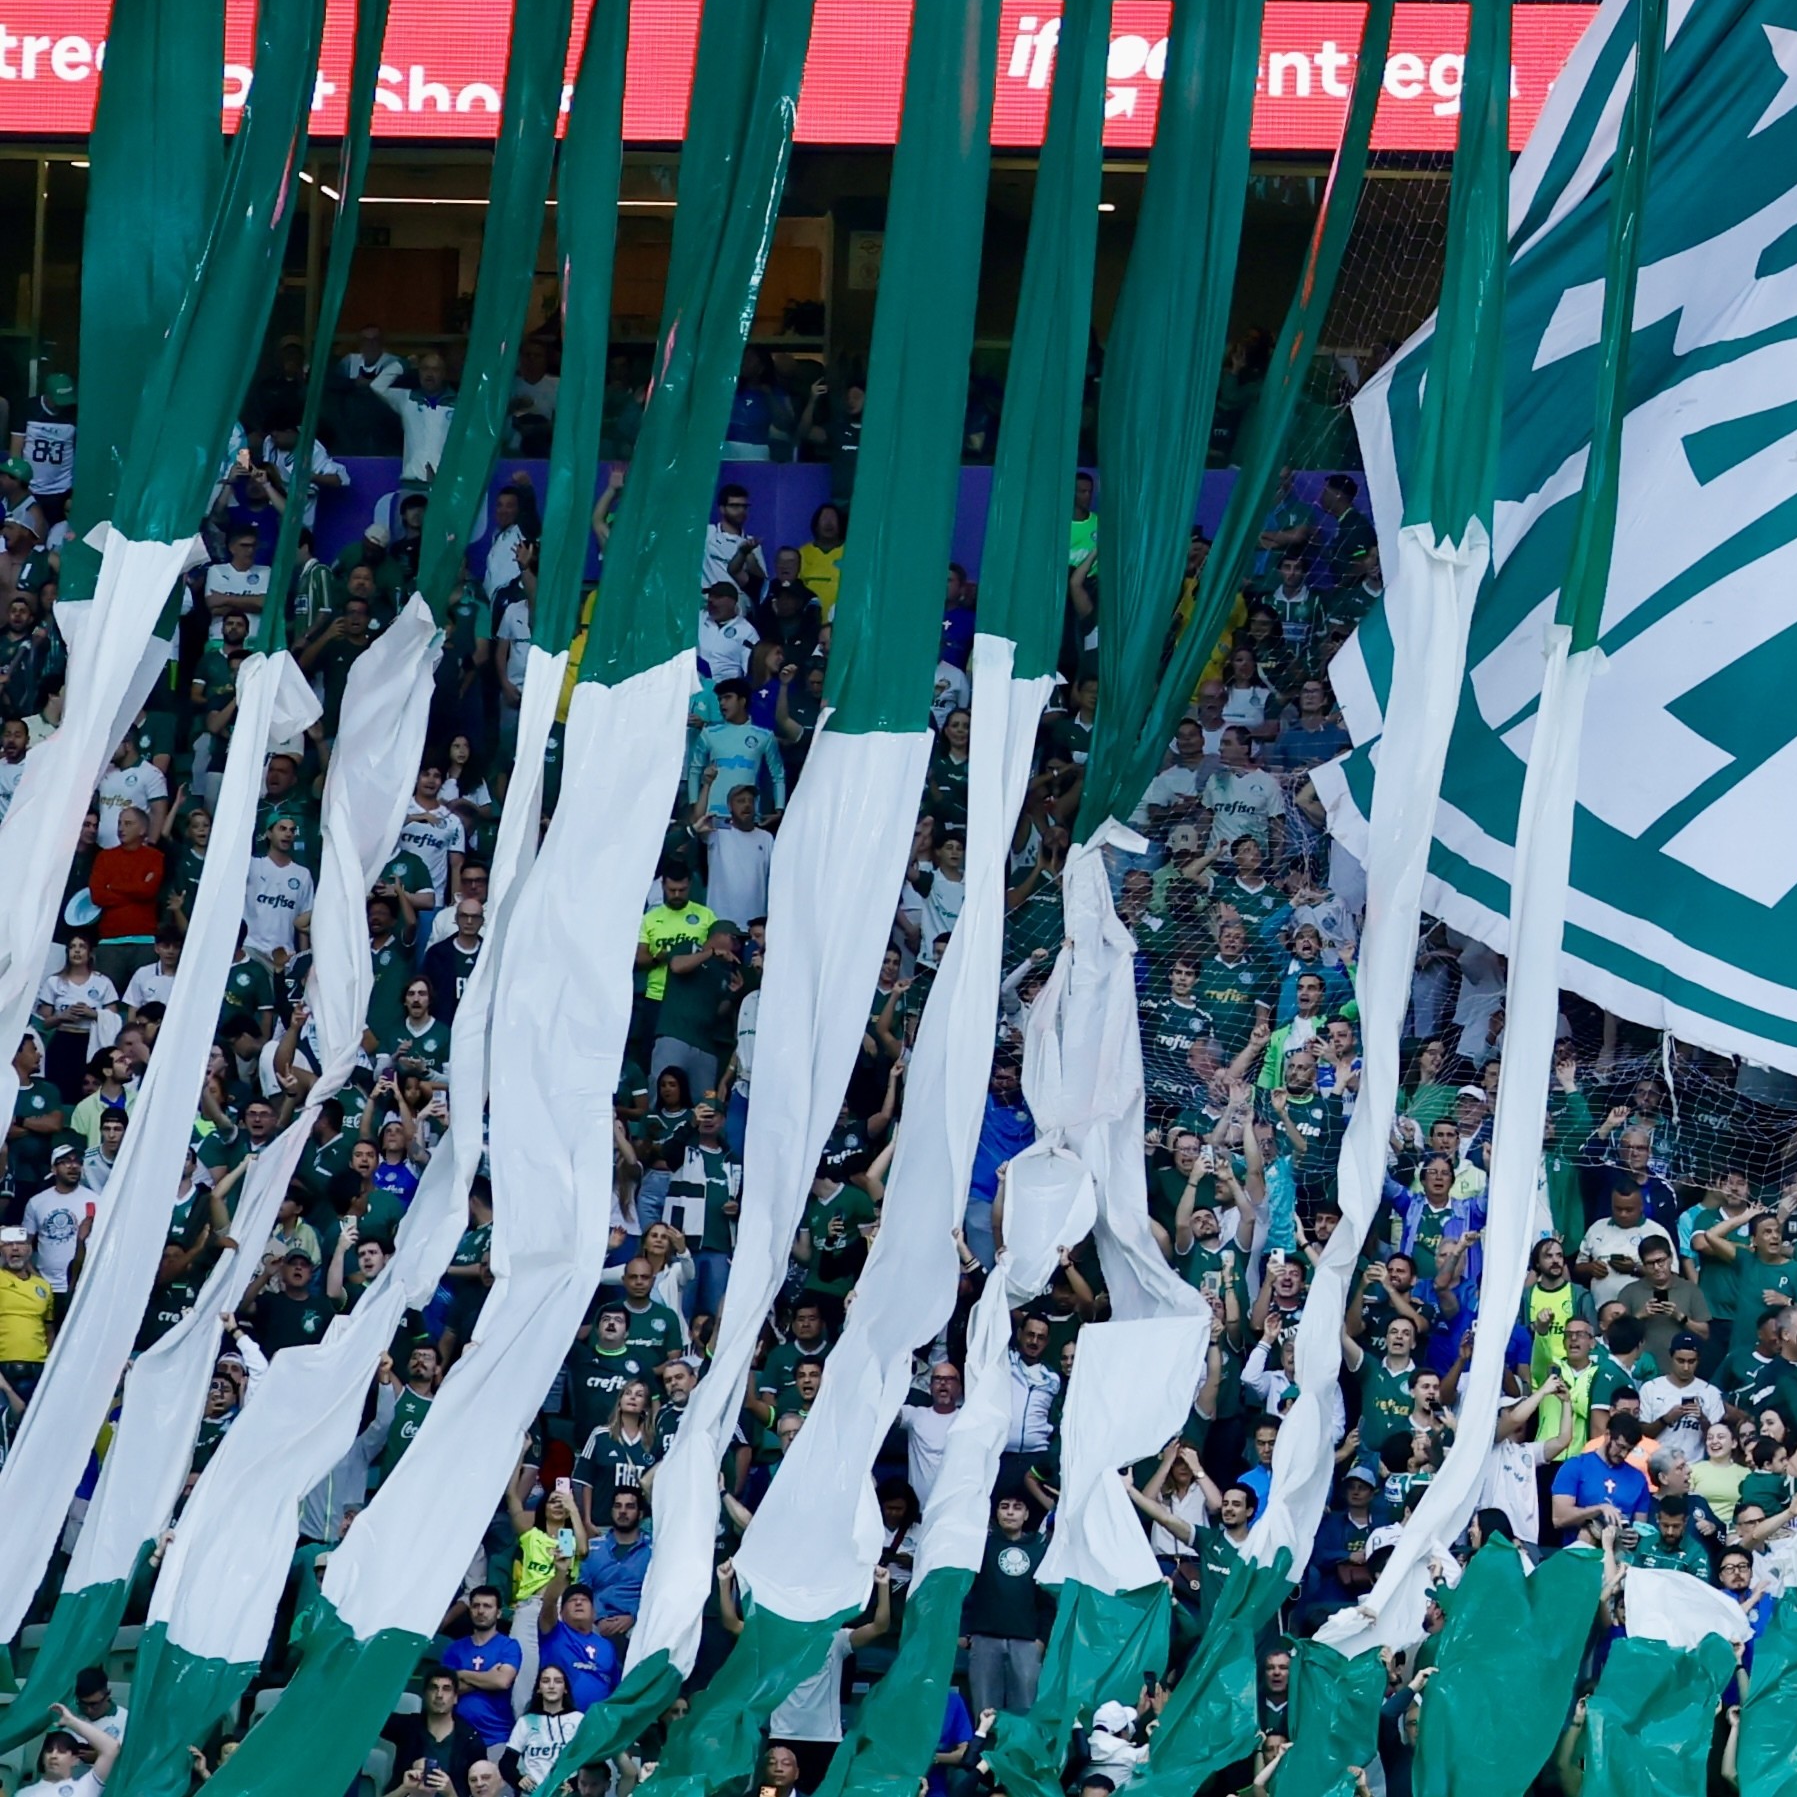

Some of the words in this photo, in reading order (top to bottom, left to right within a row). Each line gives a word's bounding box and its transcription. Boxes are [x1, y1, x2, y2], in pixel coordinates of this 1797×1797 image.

[32, 439, 64, 463] 83
[401, 834, 444, 848] crefisa
[256, 893, 295, 909] crefisa
